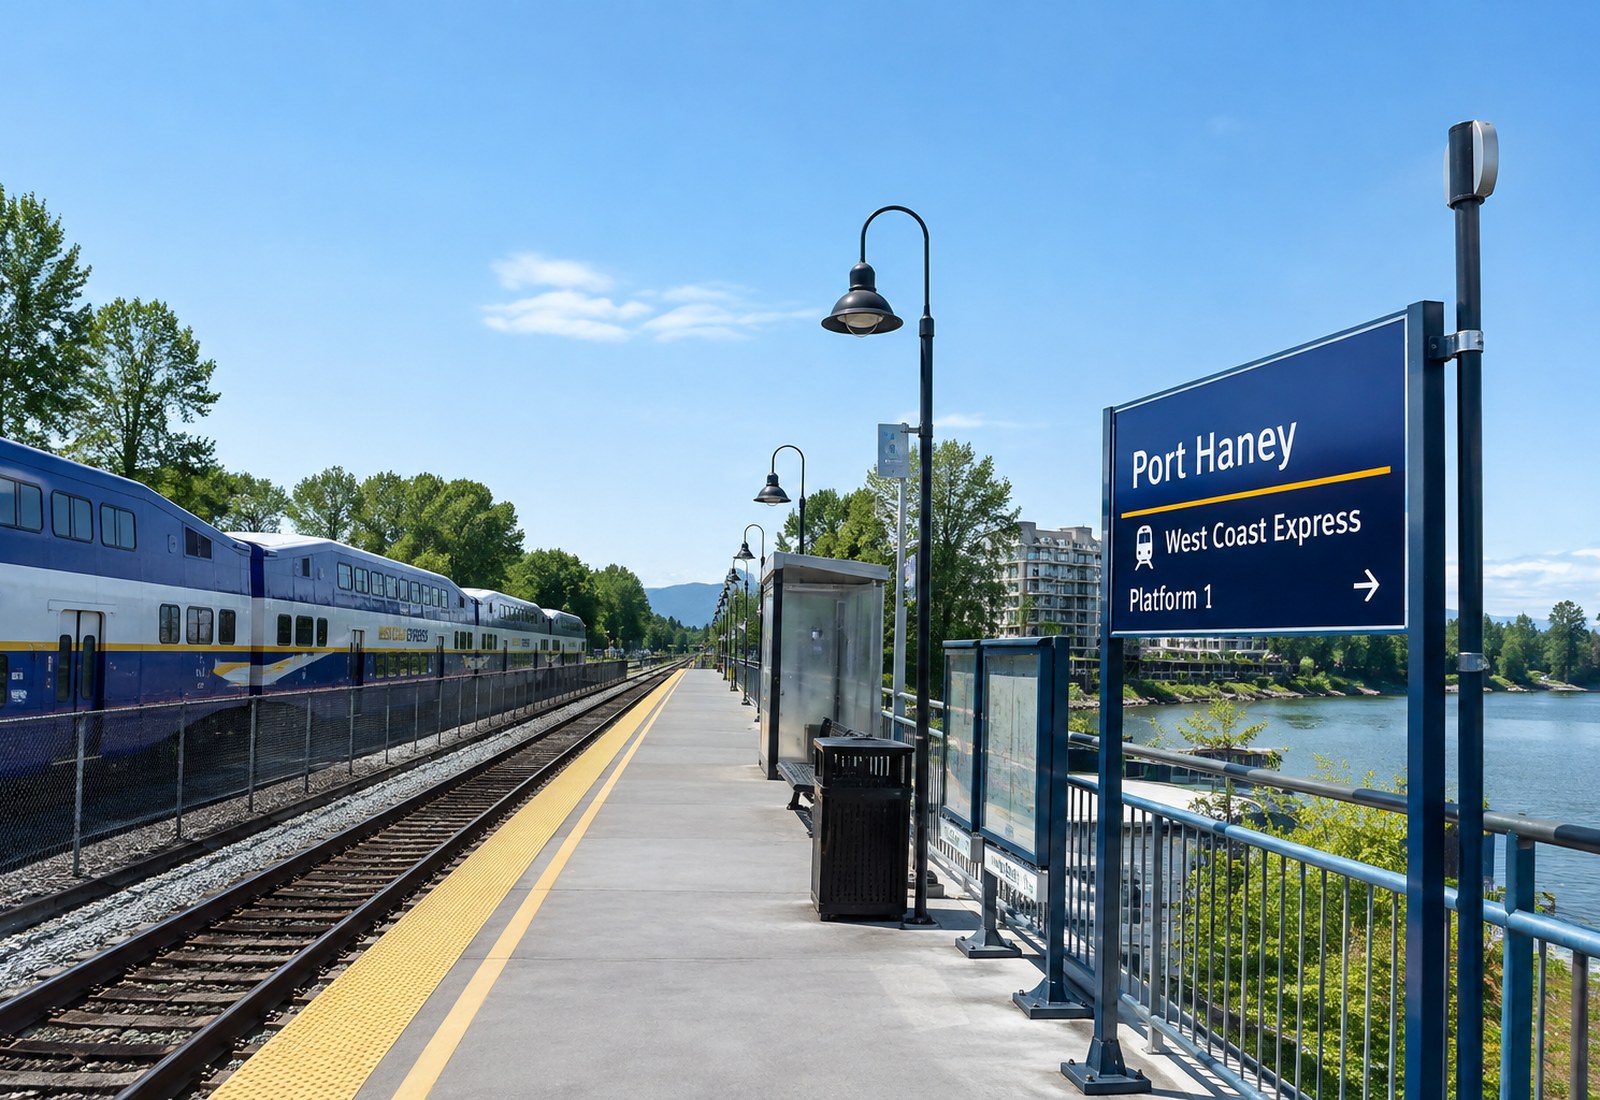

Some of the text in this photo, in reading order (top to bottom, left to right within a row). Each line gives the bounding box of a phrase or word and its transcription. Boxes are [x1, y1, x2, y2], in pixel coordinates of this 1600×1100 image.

[1132, 421, 1297, 488] Port Haney
[1165, 508, 1361, 554] West Coast Express
[1129, 583, 1213, 612] Platform 1
